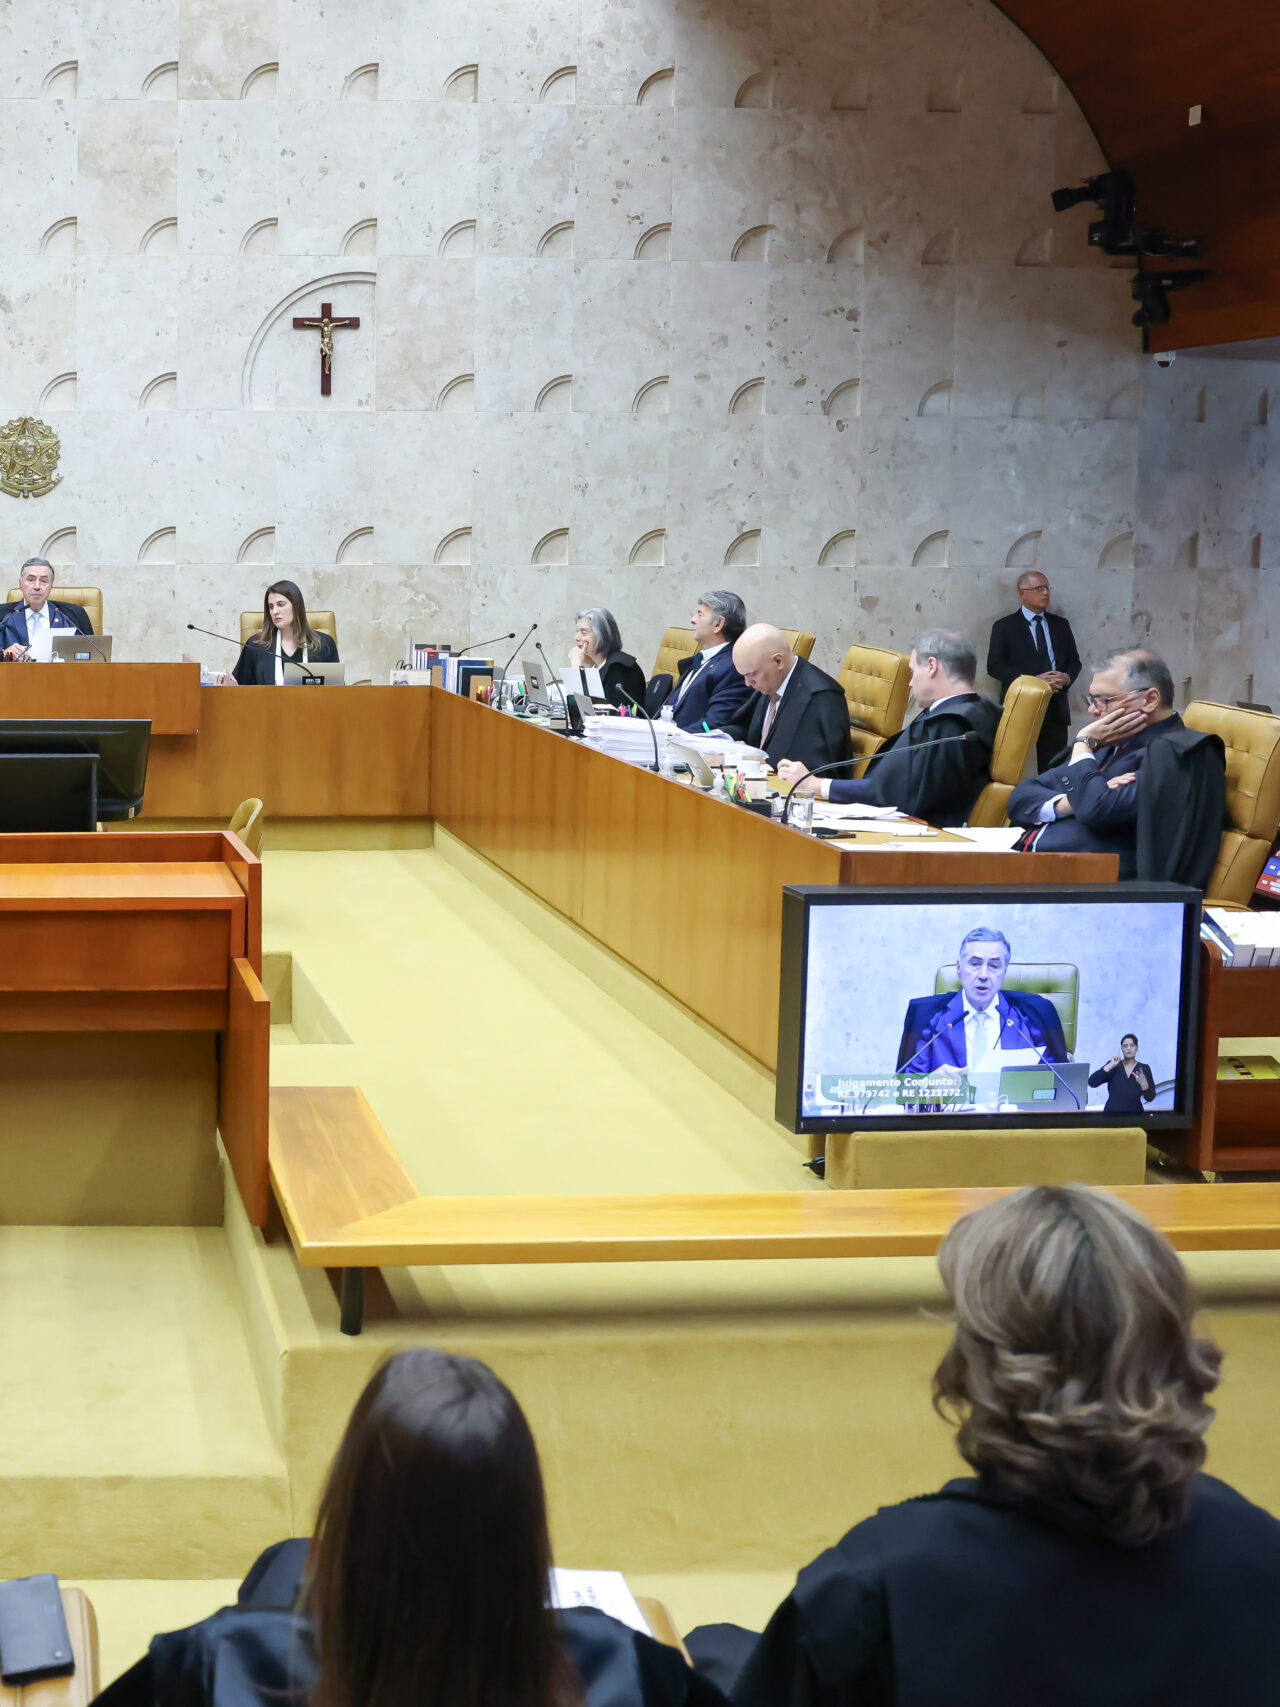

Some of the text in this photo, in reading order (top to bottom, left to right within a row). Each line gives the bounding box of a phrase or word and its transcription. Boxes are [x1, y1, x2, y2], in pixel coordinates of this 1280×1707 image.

[838, 1078, 957, 1088] Julgamento Conjunto:
[902, 1088, 915, 1097] RE
